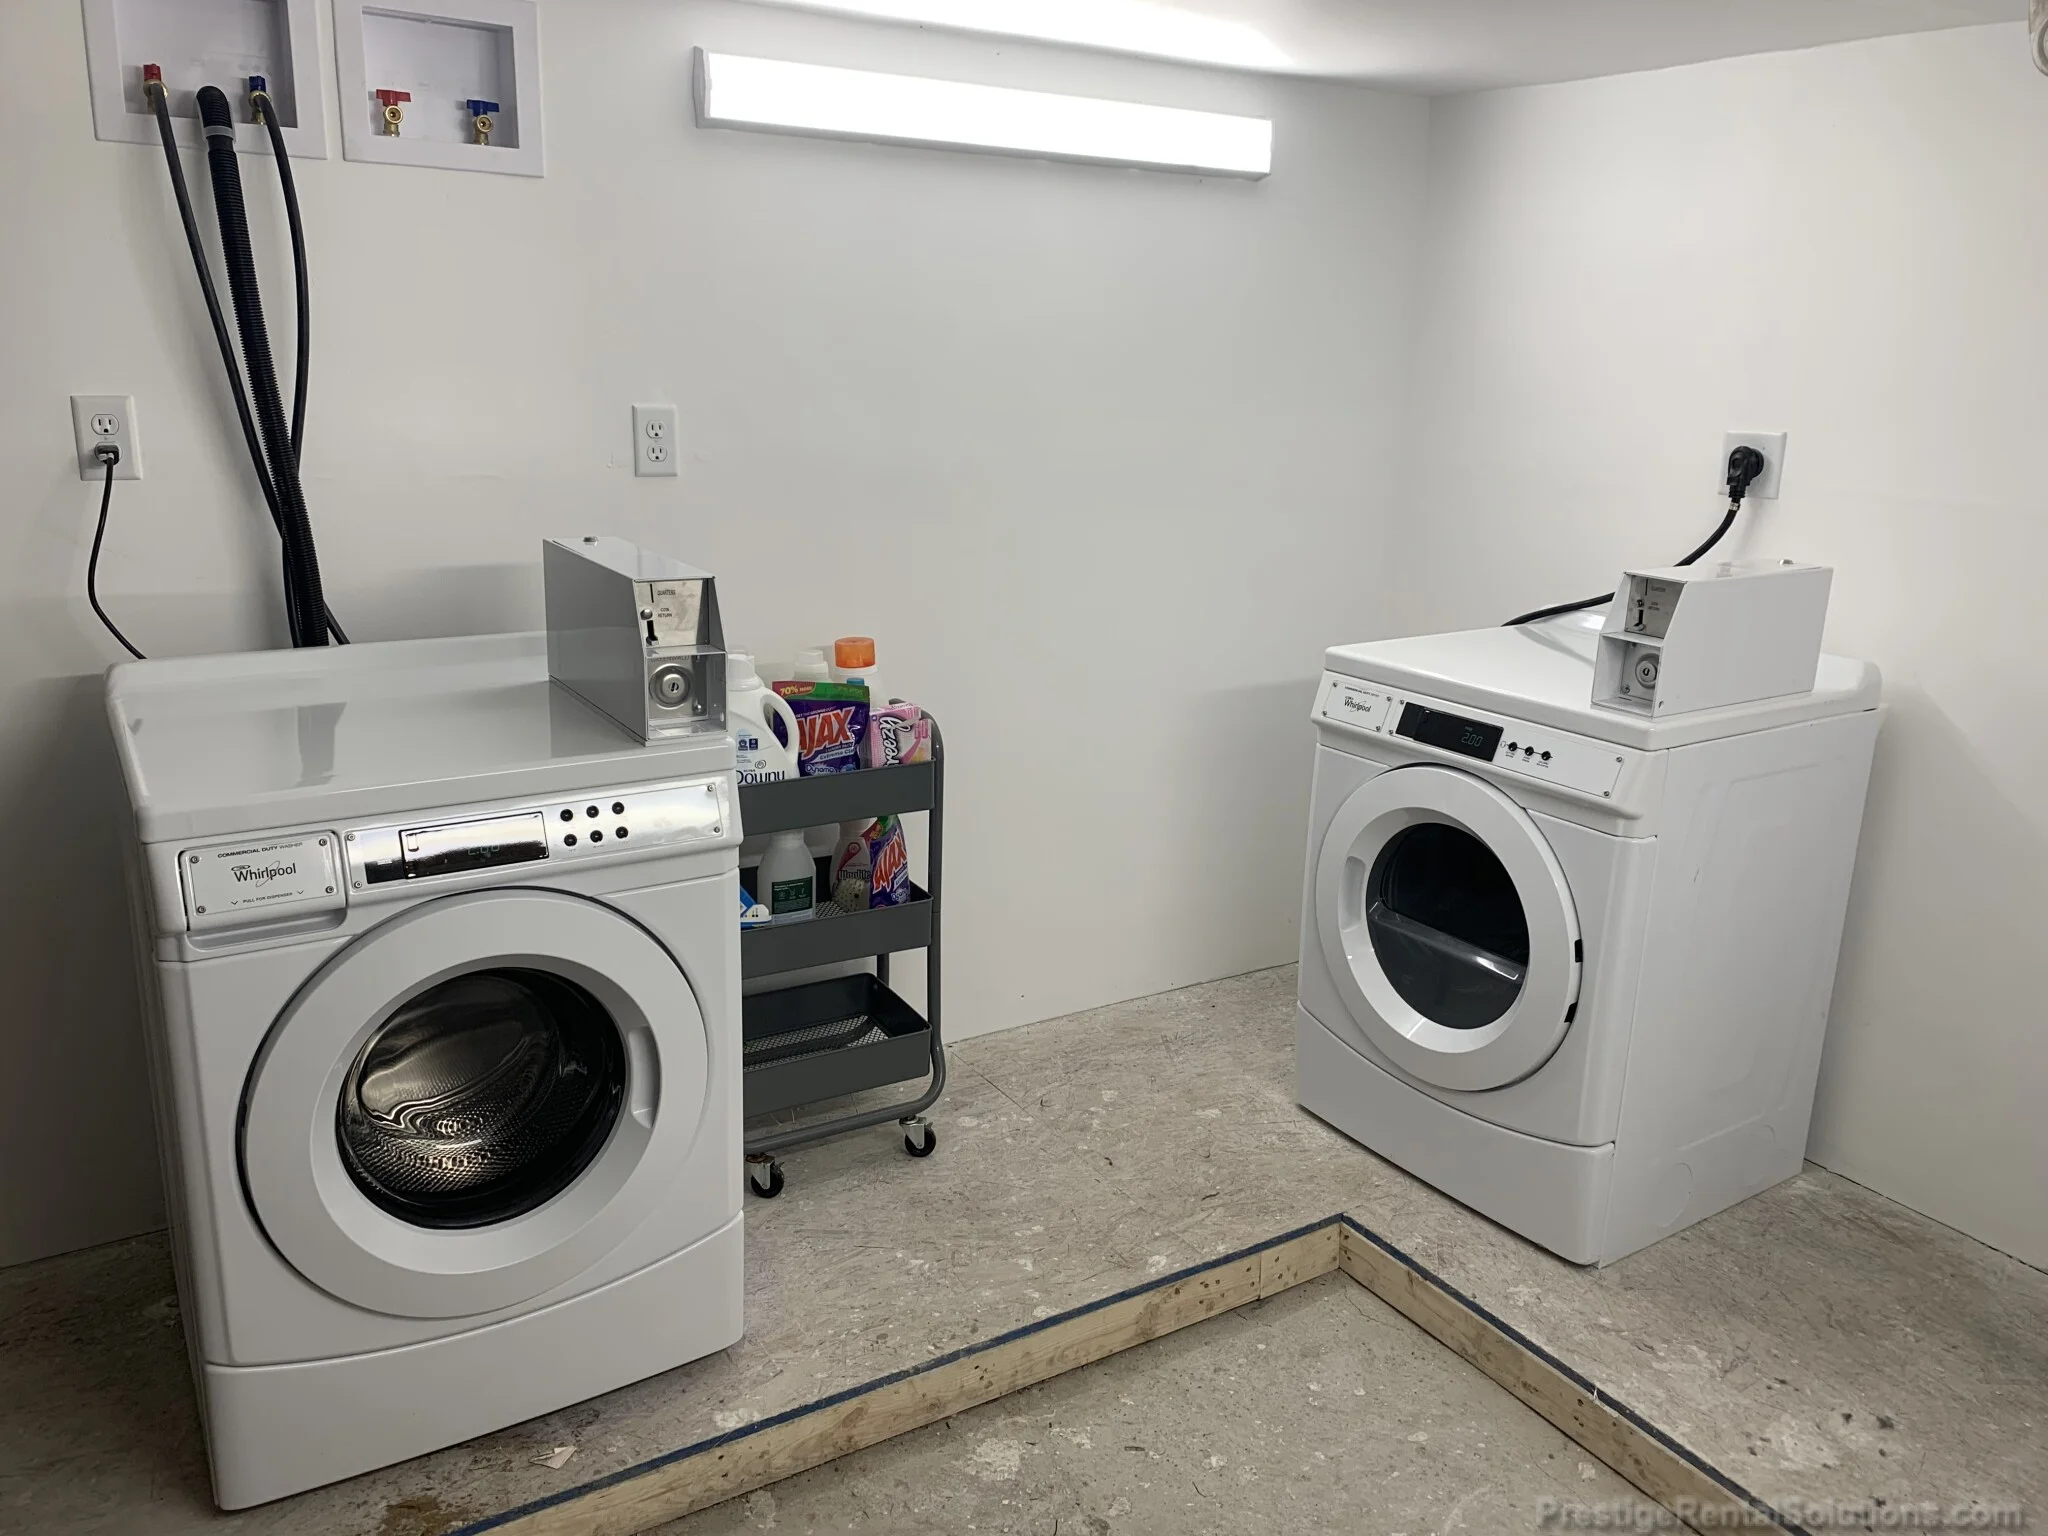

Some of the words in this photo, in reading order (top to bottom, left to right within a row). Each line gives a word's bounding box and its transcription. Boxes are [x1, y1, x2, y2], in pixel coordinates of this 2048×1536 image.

[780, 685, 799, 696] 70%
[1461, 732, 1484, 747] 2.00
[217, 848, 260, 858] COMMERCIAL
[279, 841, 303, 850] WASHER
[872, 826, 908, 895] AJAX
[234, 862, 297, 883] Whirlpool
[266, 891, 293, 900] DISPENSER
